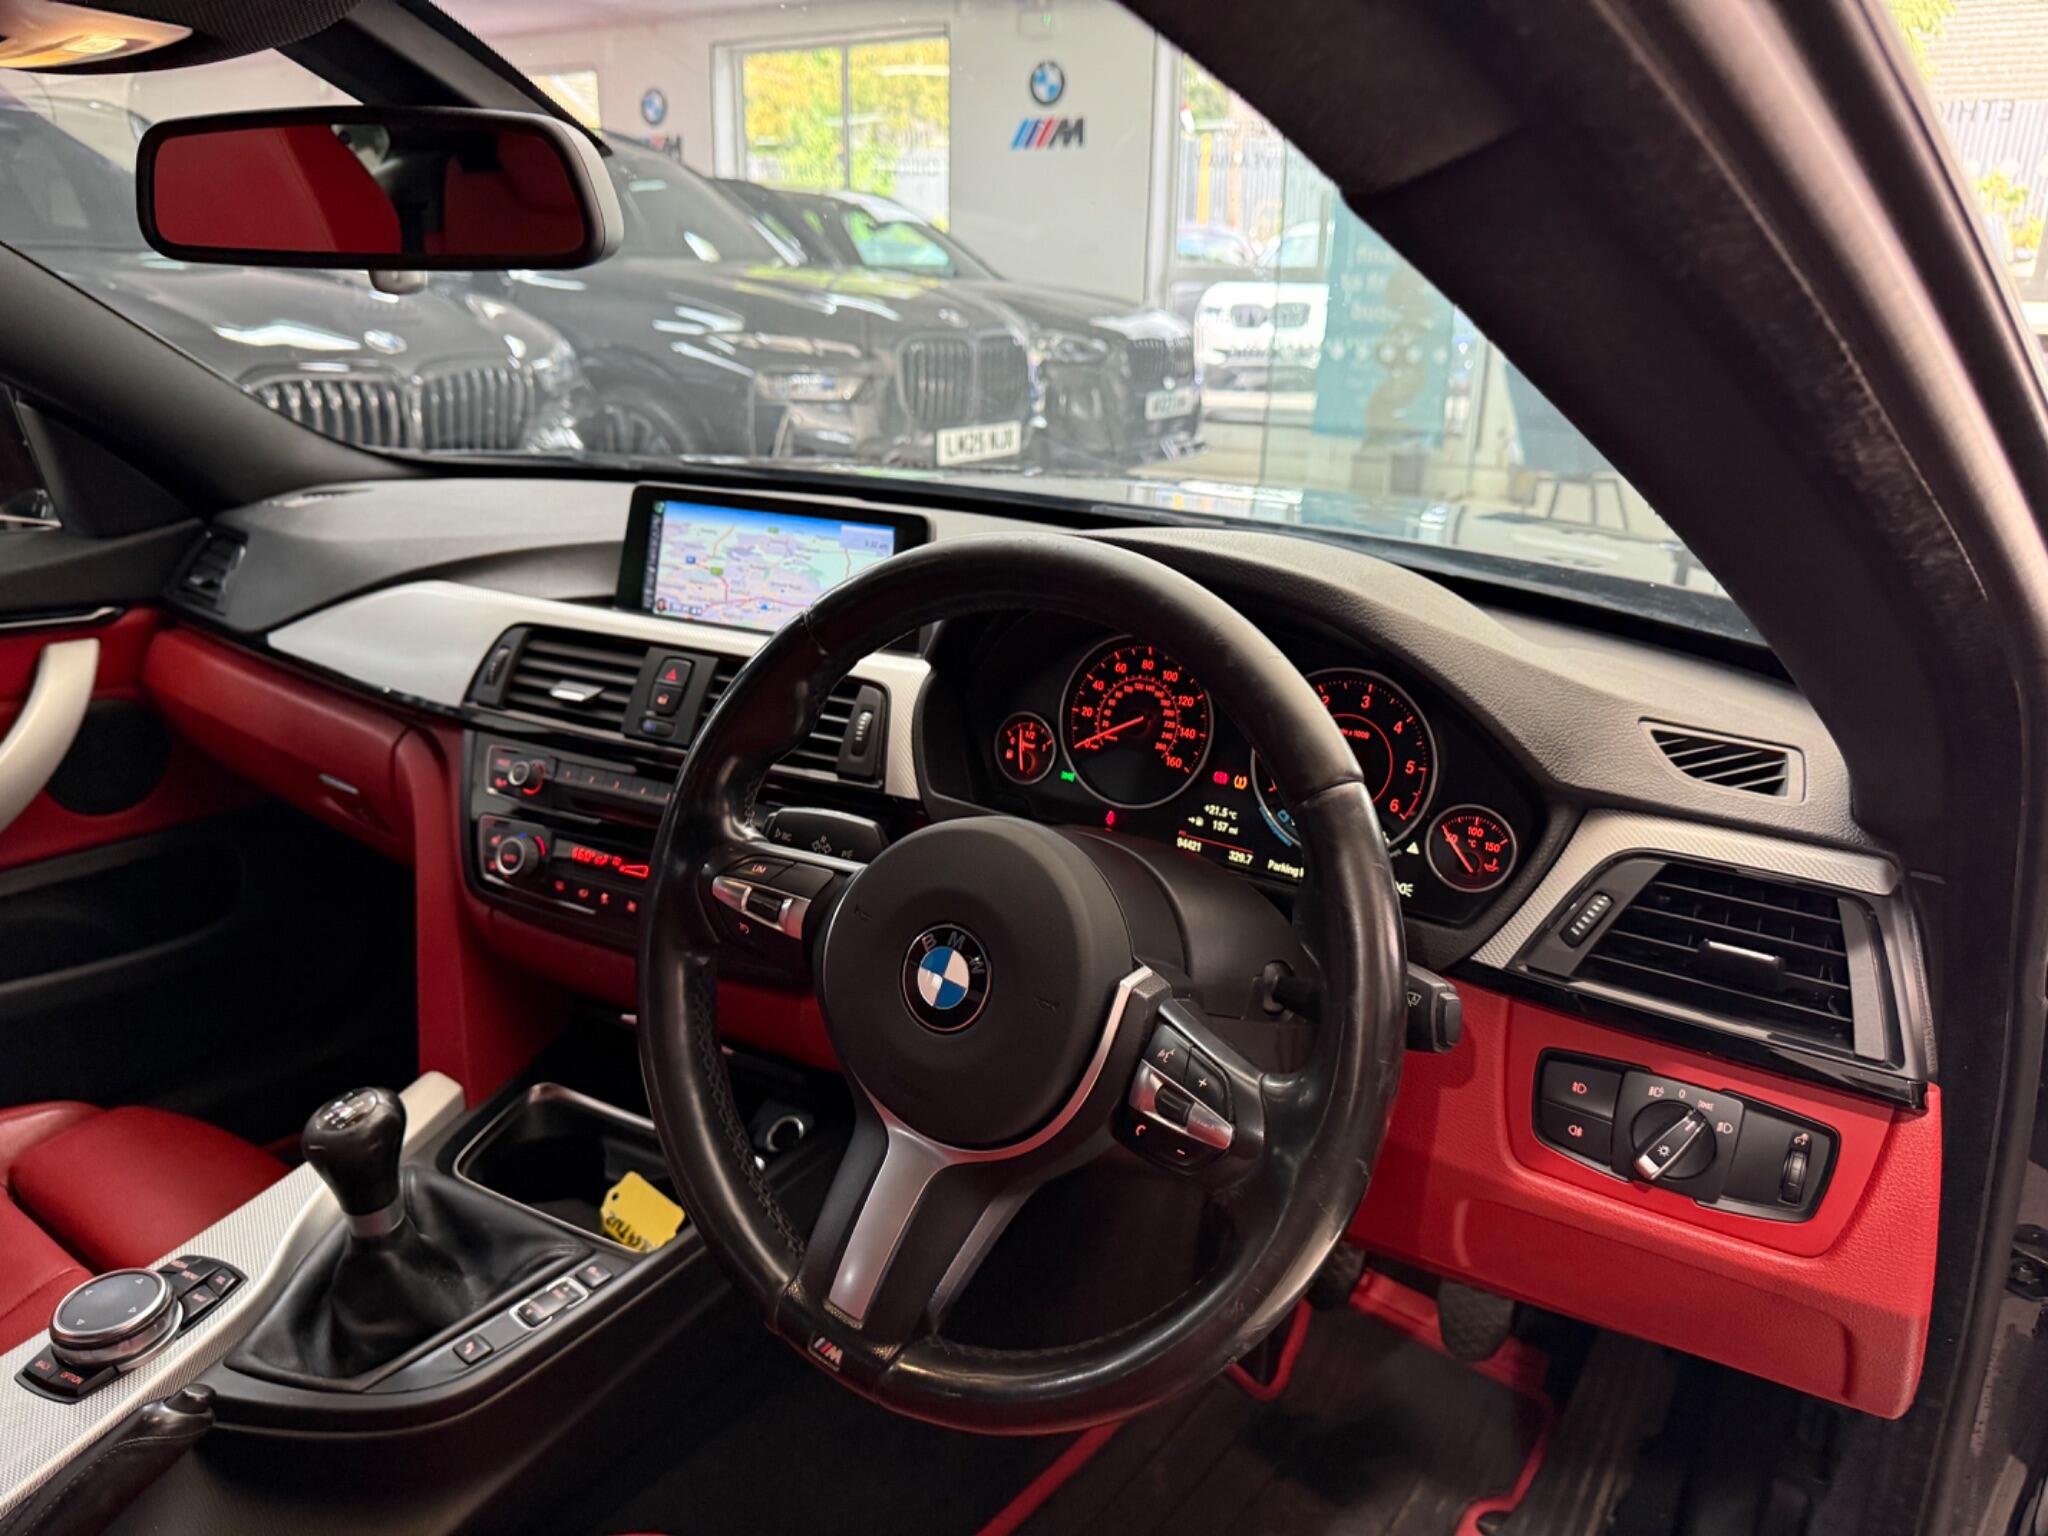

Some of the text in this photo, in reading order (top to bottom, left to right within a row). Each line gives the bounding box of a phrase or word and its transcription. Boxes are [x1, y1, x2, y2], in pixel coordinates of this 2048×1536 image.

[1114, 662, 1127, 674] 60
[1141, 659, 1154, 671] 80
[1162, 669, 1179, 682] 100
[1092, 679, 1105, 691] 40
[1178, 695, 1195, 708] 120
[1360, 694, 1371, 709] 3
[1081, 705, 1094, 717] 20
[1393, 720, 1404, 734] 4
[1180, 728, 1196, 740] 140
[1165, 755, 1183, 769] 160
[1404, 760, 1416, 775] 5
[1389, 798, 1400, 813] 6
[1467, 825, 1485, 838] 100
[1484, 841, 1502, 854] 150
[1267, 858, 1299, 879] Parking
